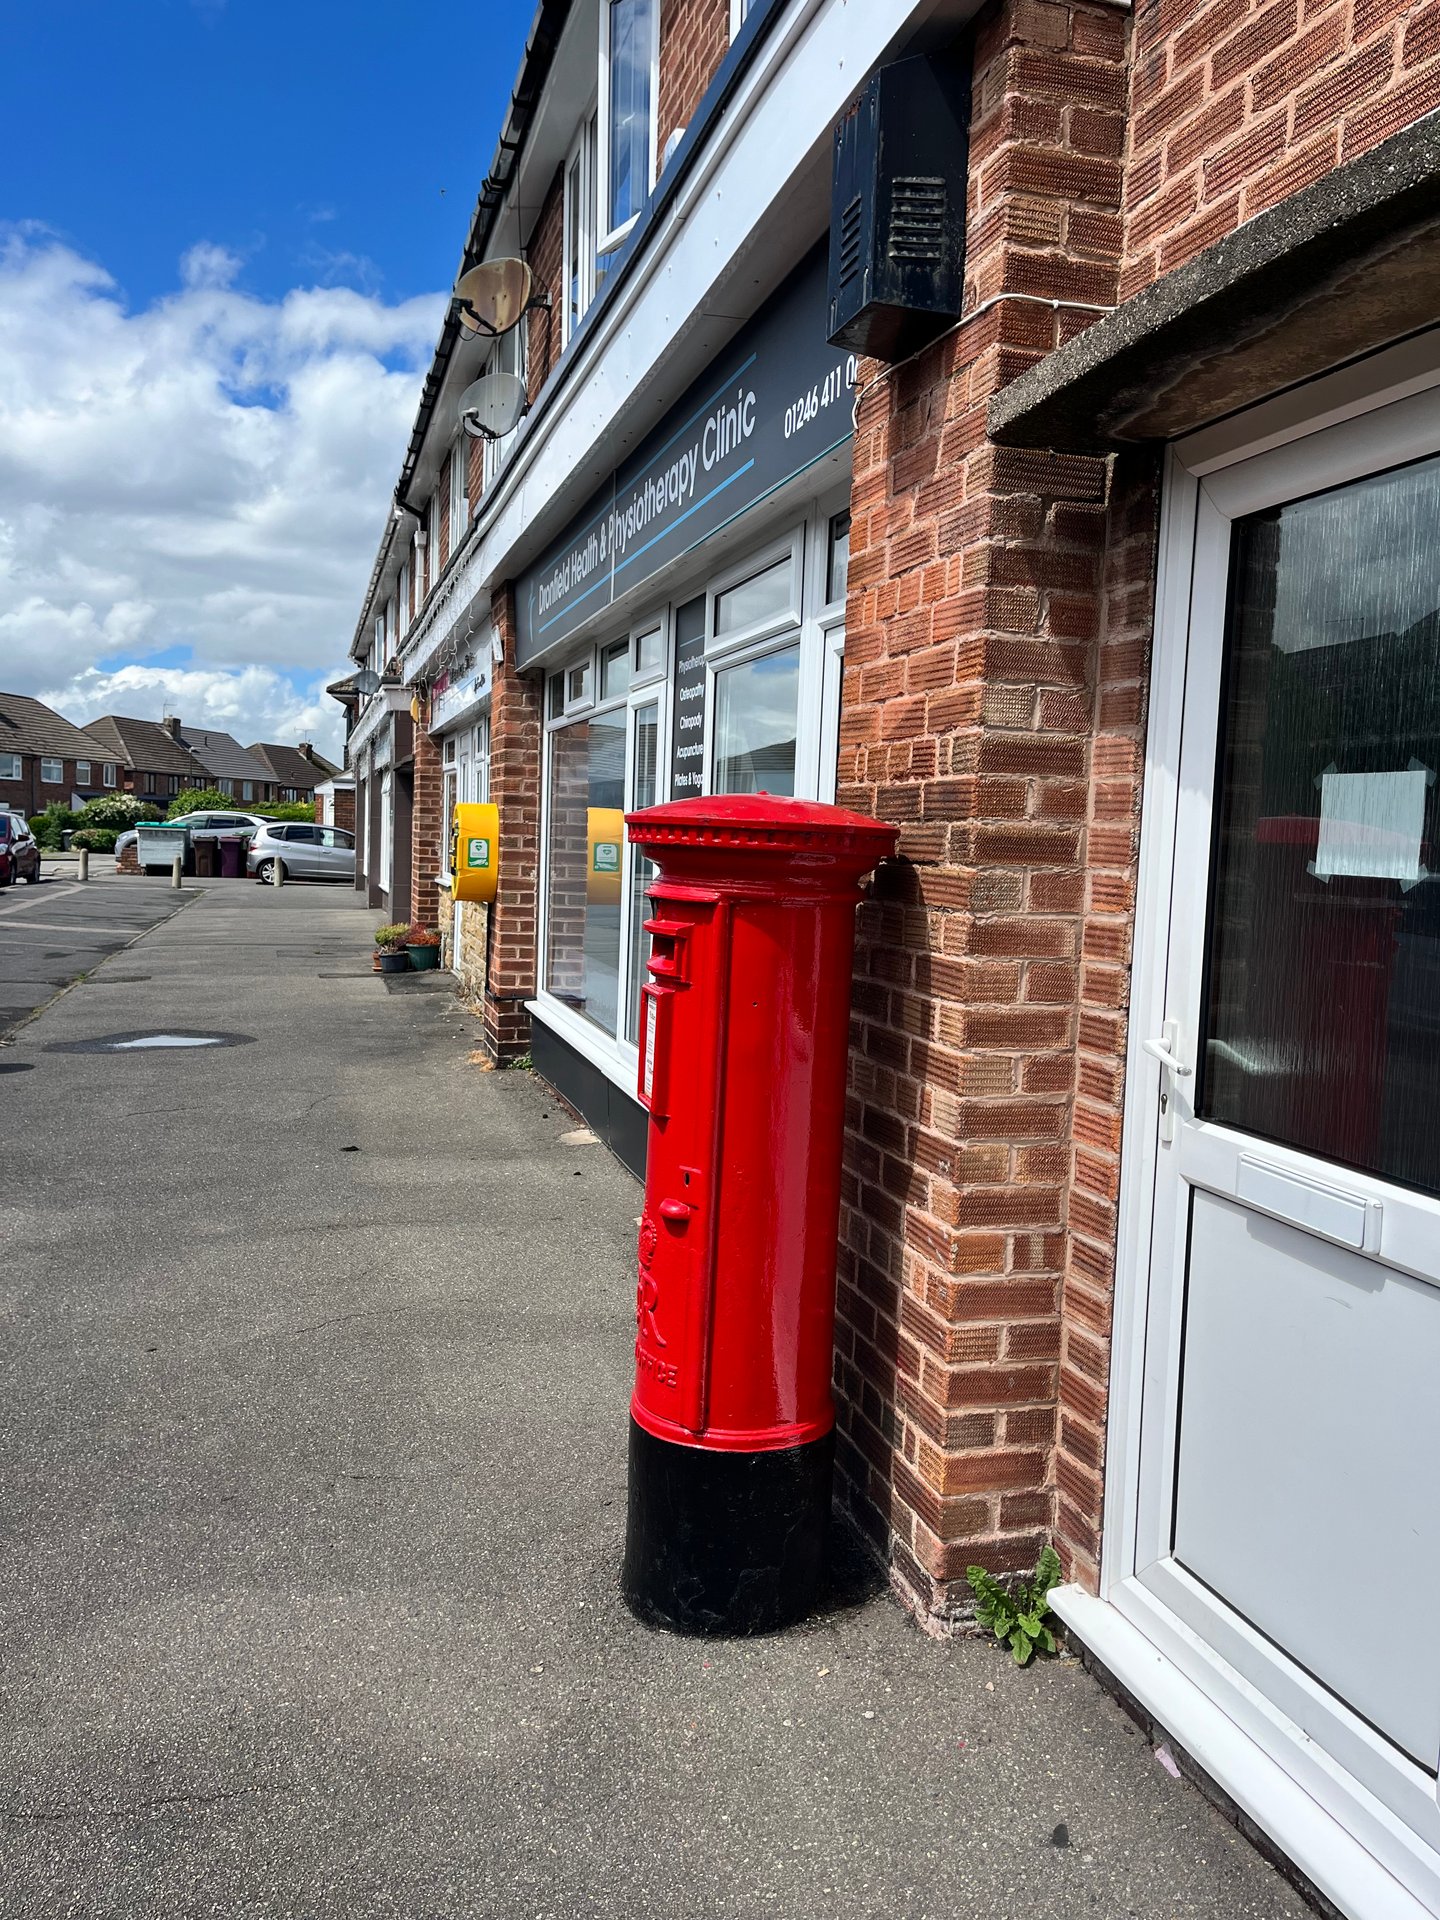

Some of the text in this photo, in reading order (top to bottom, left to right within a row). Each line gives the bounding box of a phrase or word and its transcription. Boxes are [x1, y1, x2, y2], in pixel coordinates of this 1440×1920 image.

[784, 385, 818, 439] 01246
[821, 365, 841, 408] 411
[538, 388, 756, 615] Dronfield Health & Physiotherapy Clinic
[680, 682, 705, 702] Osteopathy
[680, 712, 702, 730] Chiropody
[676, 742, 704, 760] Acupuncture
[674, 773, 688, 787] Pilates
